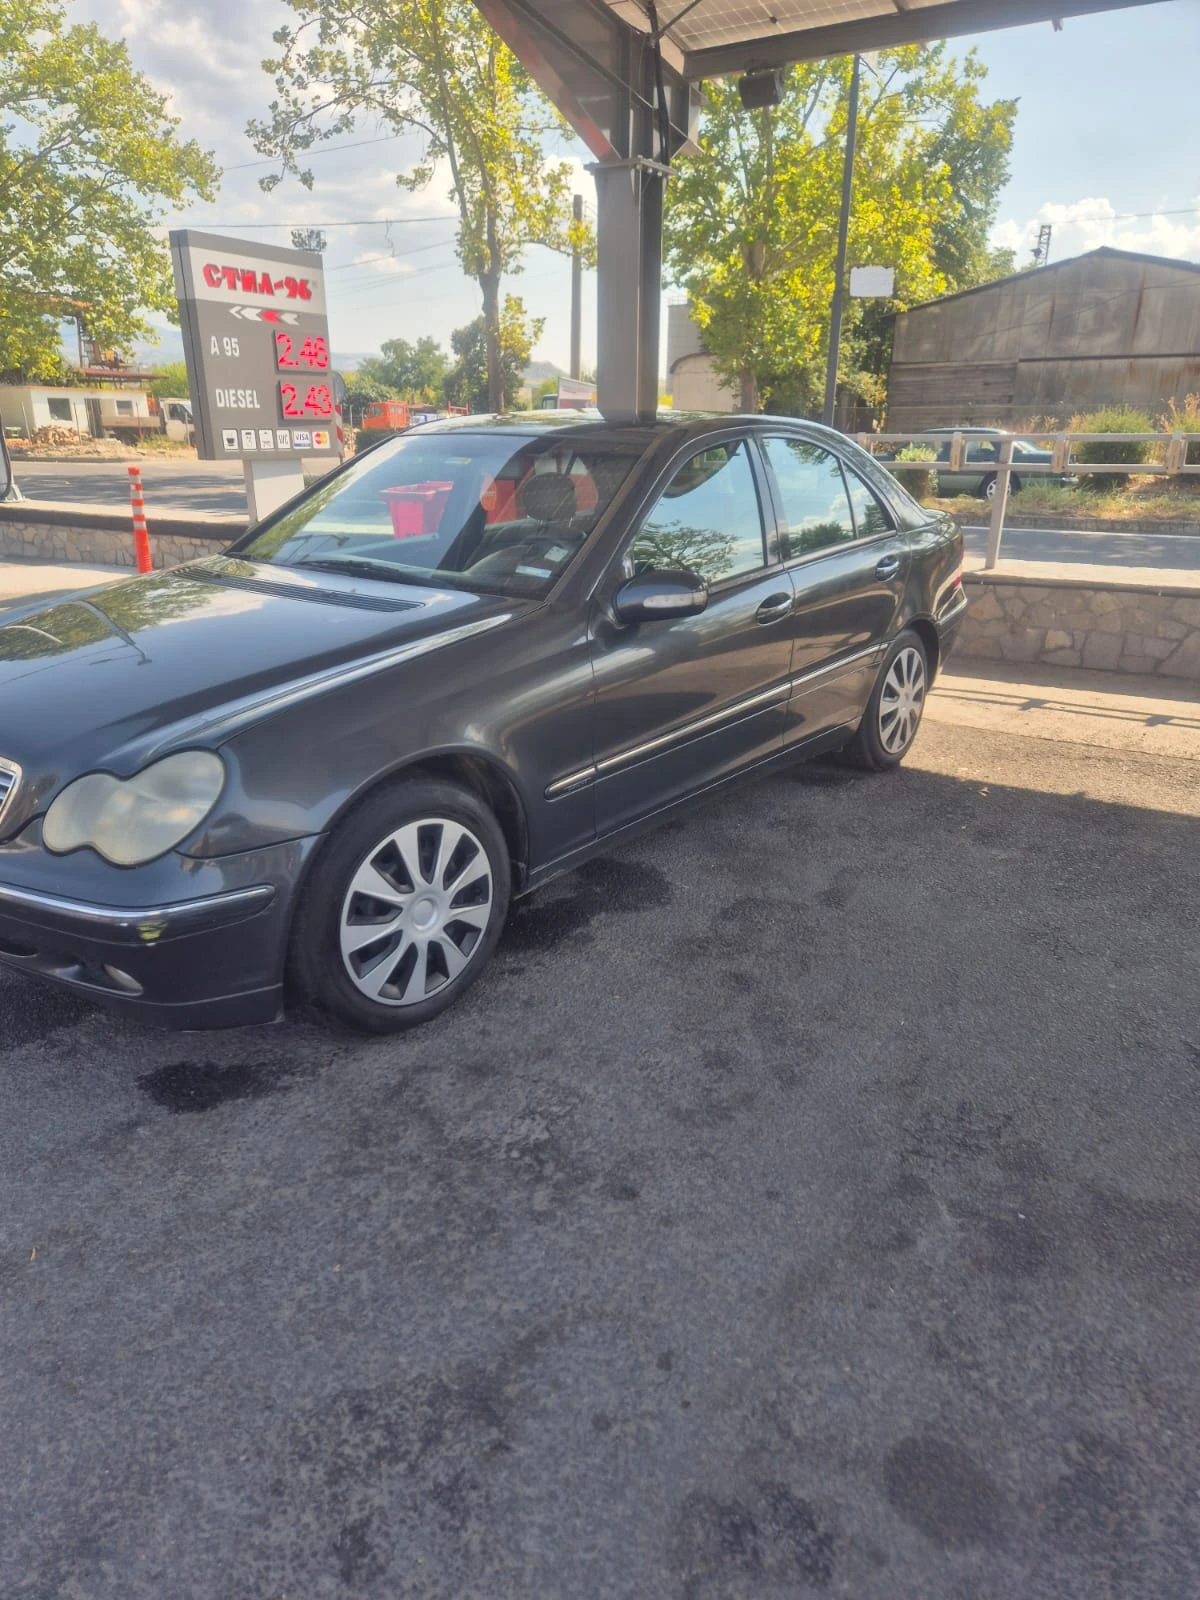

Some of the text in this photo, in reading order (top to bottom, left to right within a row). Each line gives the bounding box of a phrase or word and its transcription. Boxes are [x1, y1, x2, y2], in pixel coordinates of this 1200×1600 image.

[210, 335, 240, 357] A 95
[276, 333, 329, 368] 2.46
[215, 388, 260, 409] DIESEL
[281, 383, 332, 416] 2.43
[295, 433, 309, 441] VISA
